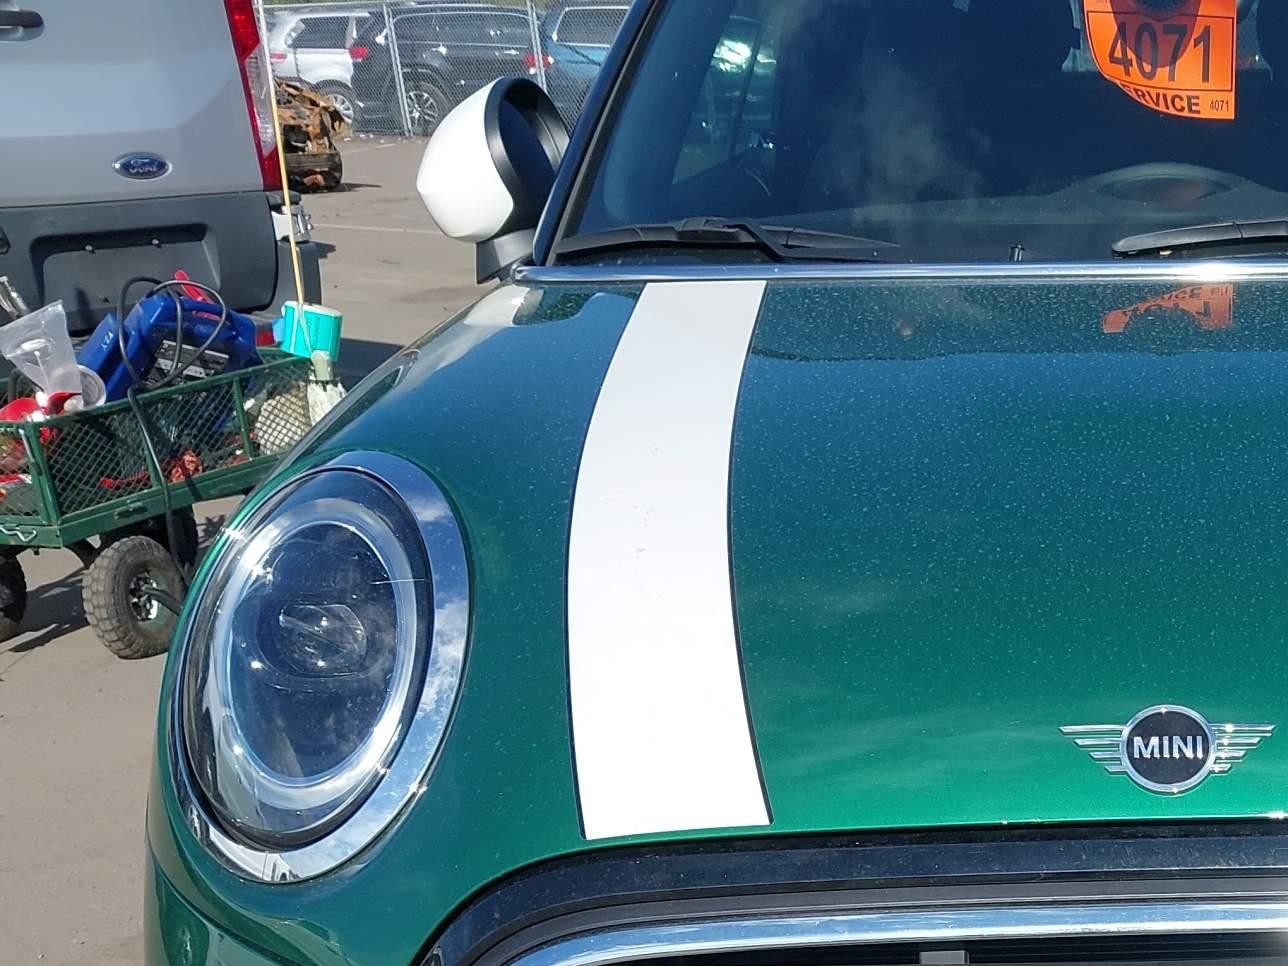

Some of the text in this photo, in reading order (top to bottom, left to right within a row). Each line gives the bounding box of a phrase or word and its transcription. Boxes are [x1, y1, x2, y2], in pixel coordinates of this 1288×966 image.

[1108, 22, 1211, 83] 4071
[1209, 100, 1229, 113] 4071
[1133, 735, 1203, 759] MINI
